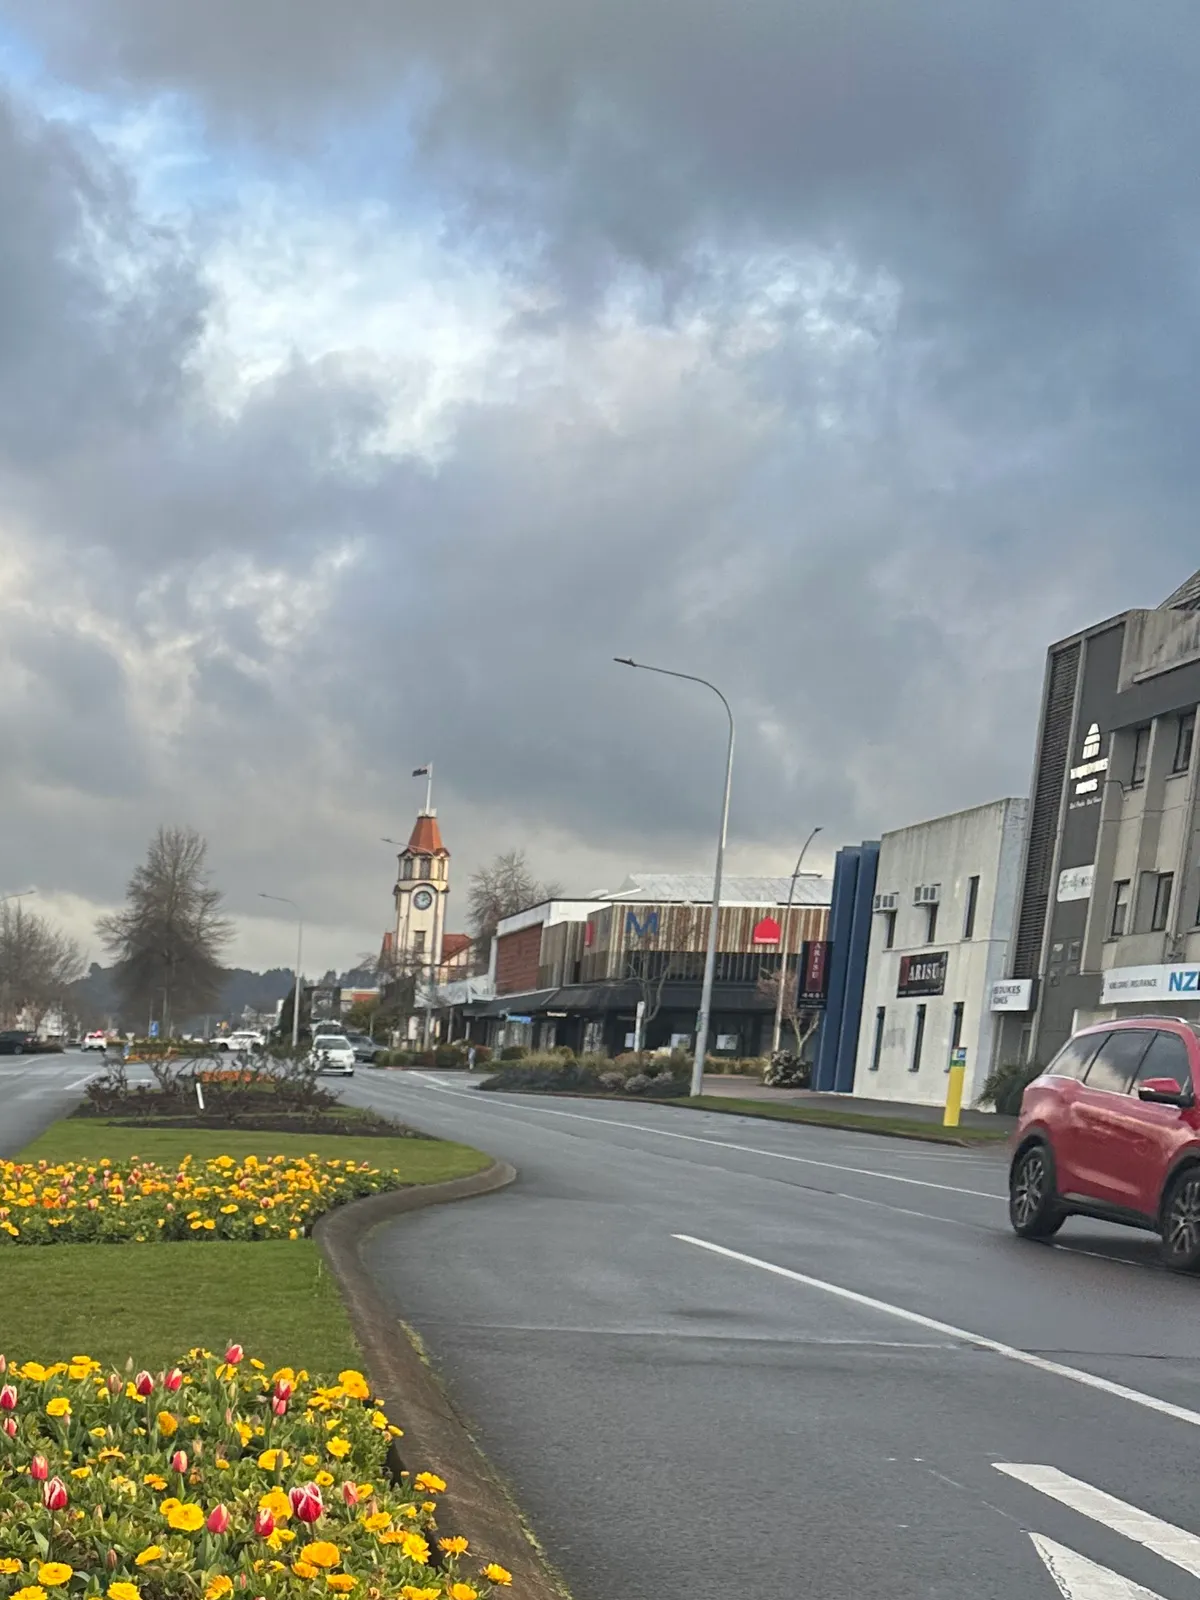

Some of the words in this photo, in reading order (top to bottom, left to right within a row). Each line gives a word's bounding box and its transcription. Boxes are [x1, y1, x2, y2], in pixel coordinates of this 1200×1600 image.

[812, 942, 821, 979] ARISU
[907, 962, 939, 981] ARISU
[1168, 971, 1200, 992] NZ
